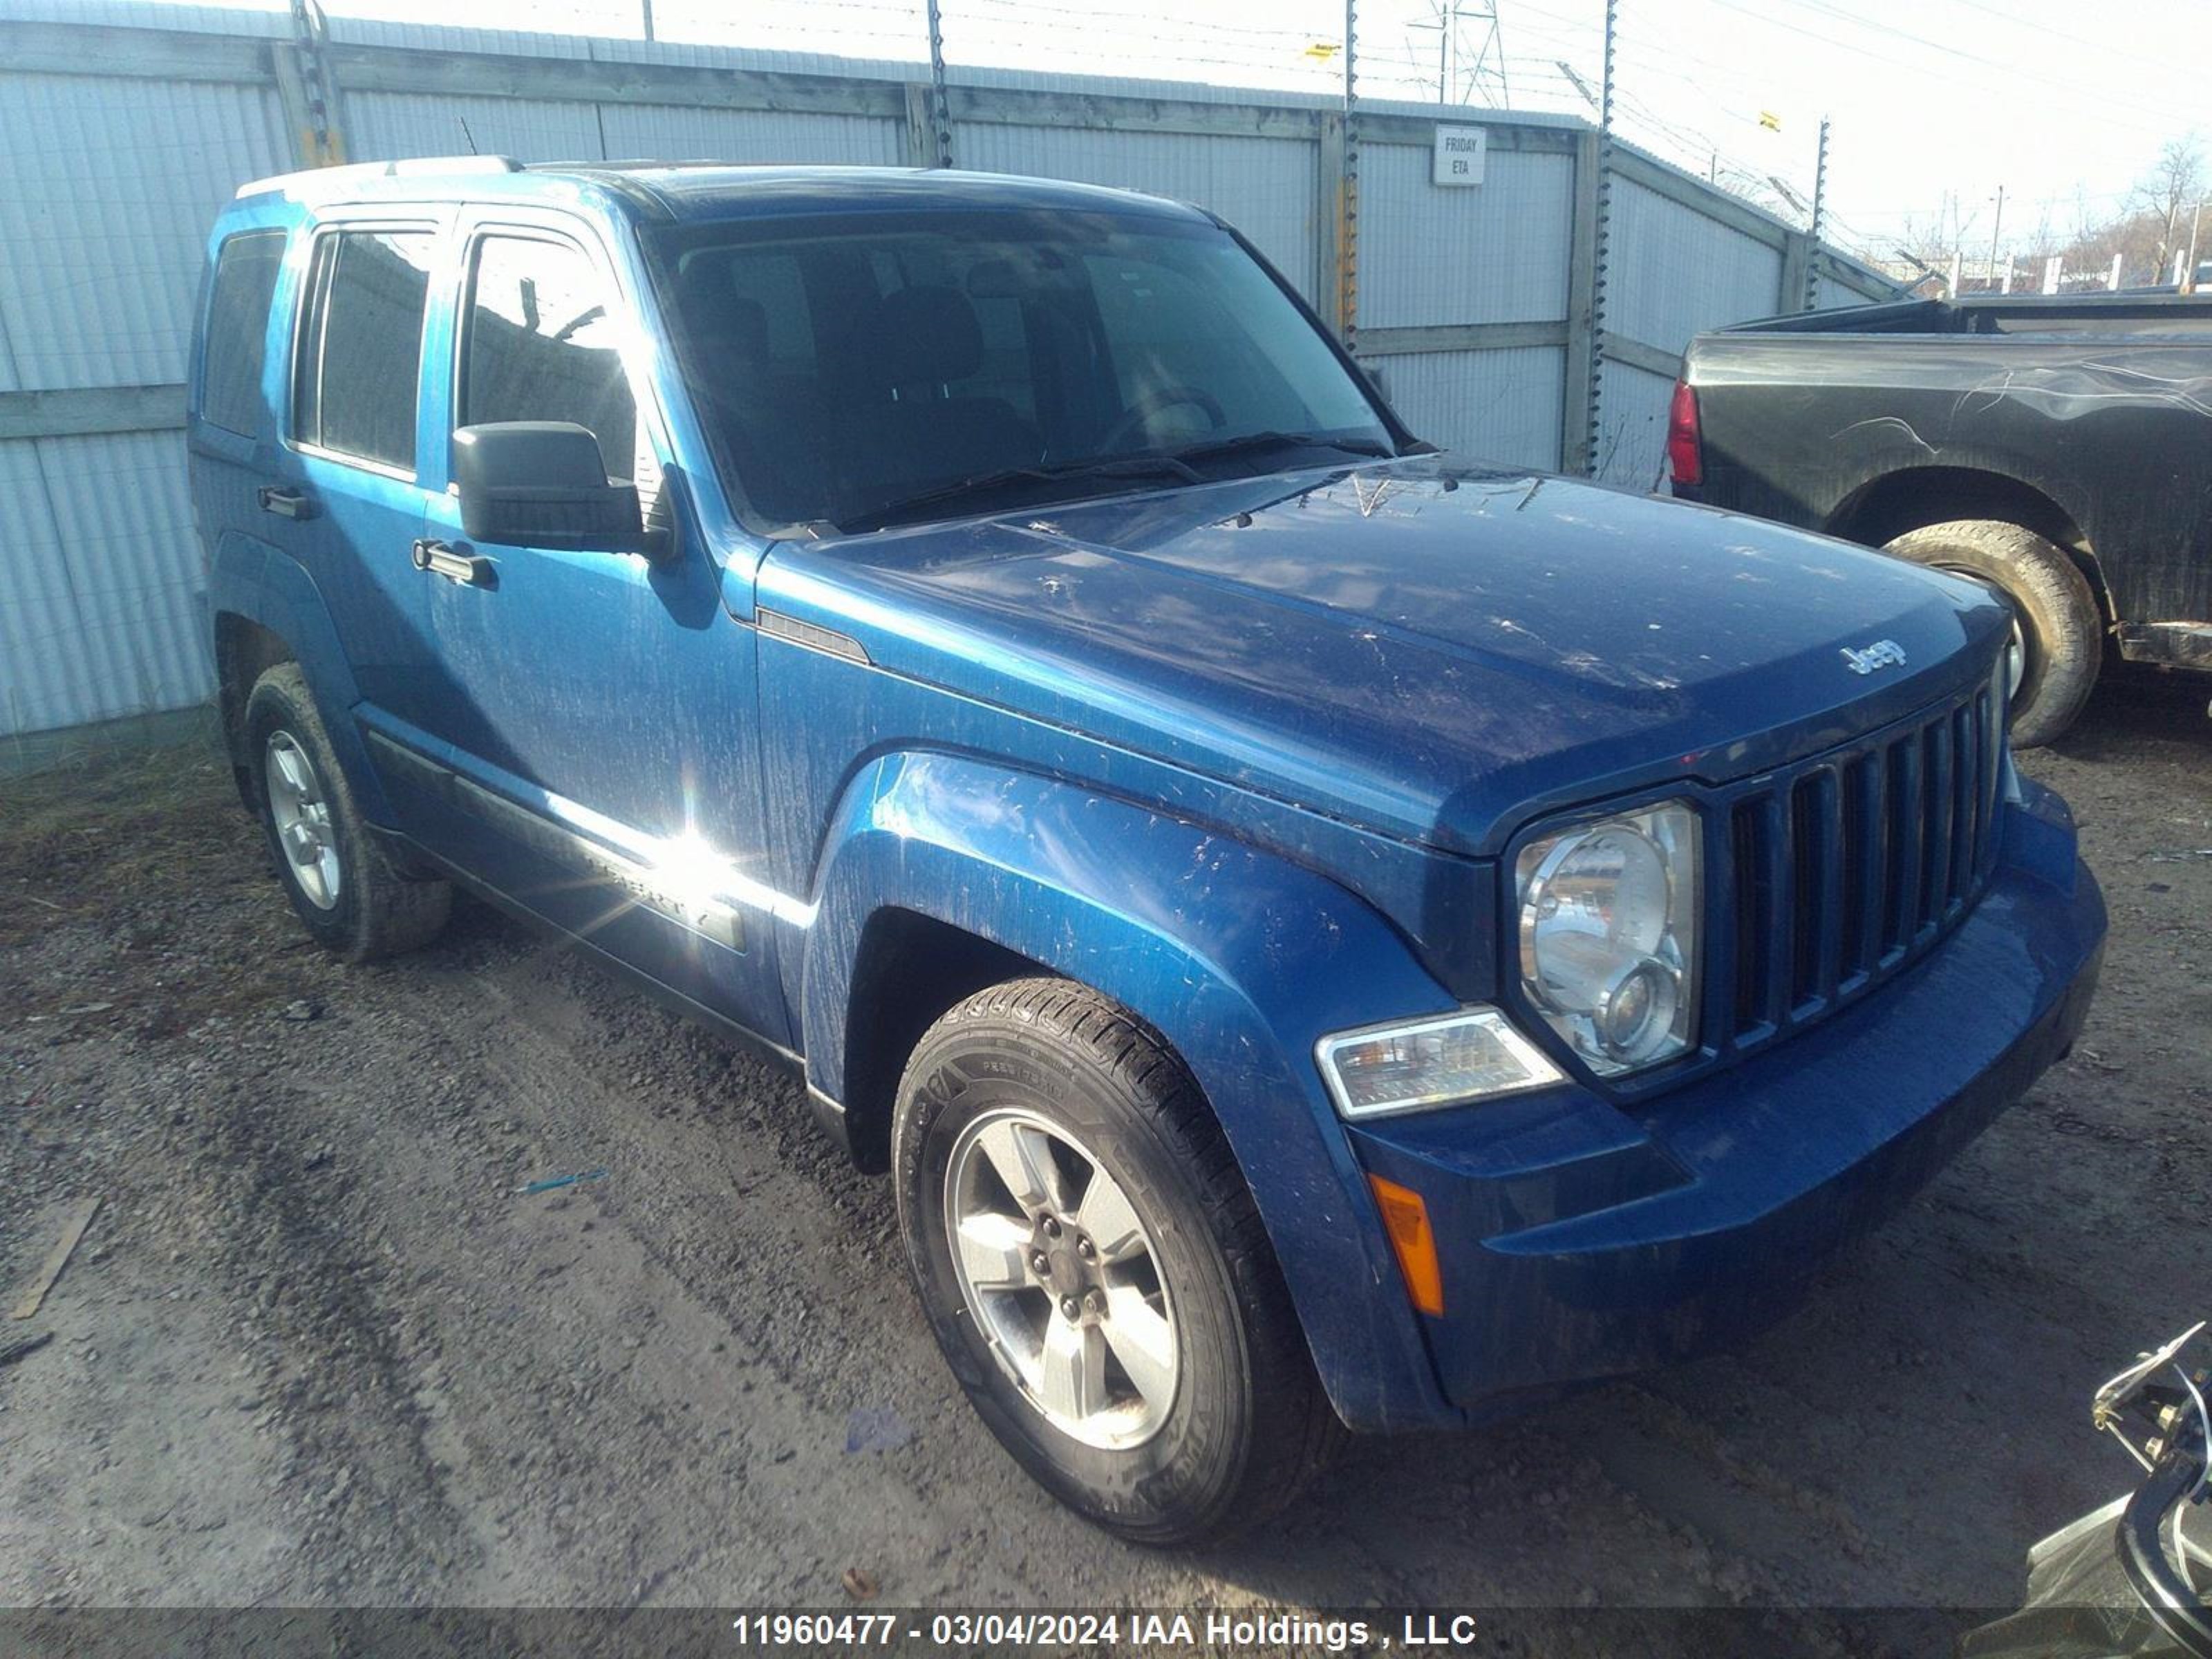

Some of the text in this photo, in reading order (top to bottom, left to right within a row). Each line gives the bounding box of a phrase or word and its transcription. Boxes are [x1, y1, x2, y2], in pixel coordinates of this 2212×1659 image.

[1445, 137, 1477, 153] FRIDAY
[1452, 160, 1469, 174] ETA
[1839, 639, 1906, 675] Jeep
